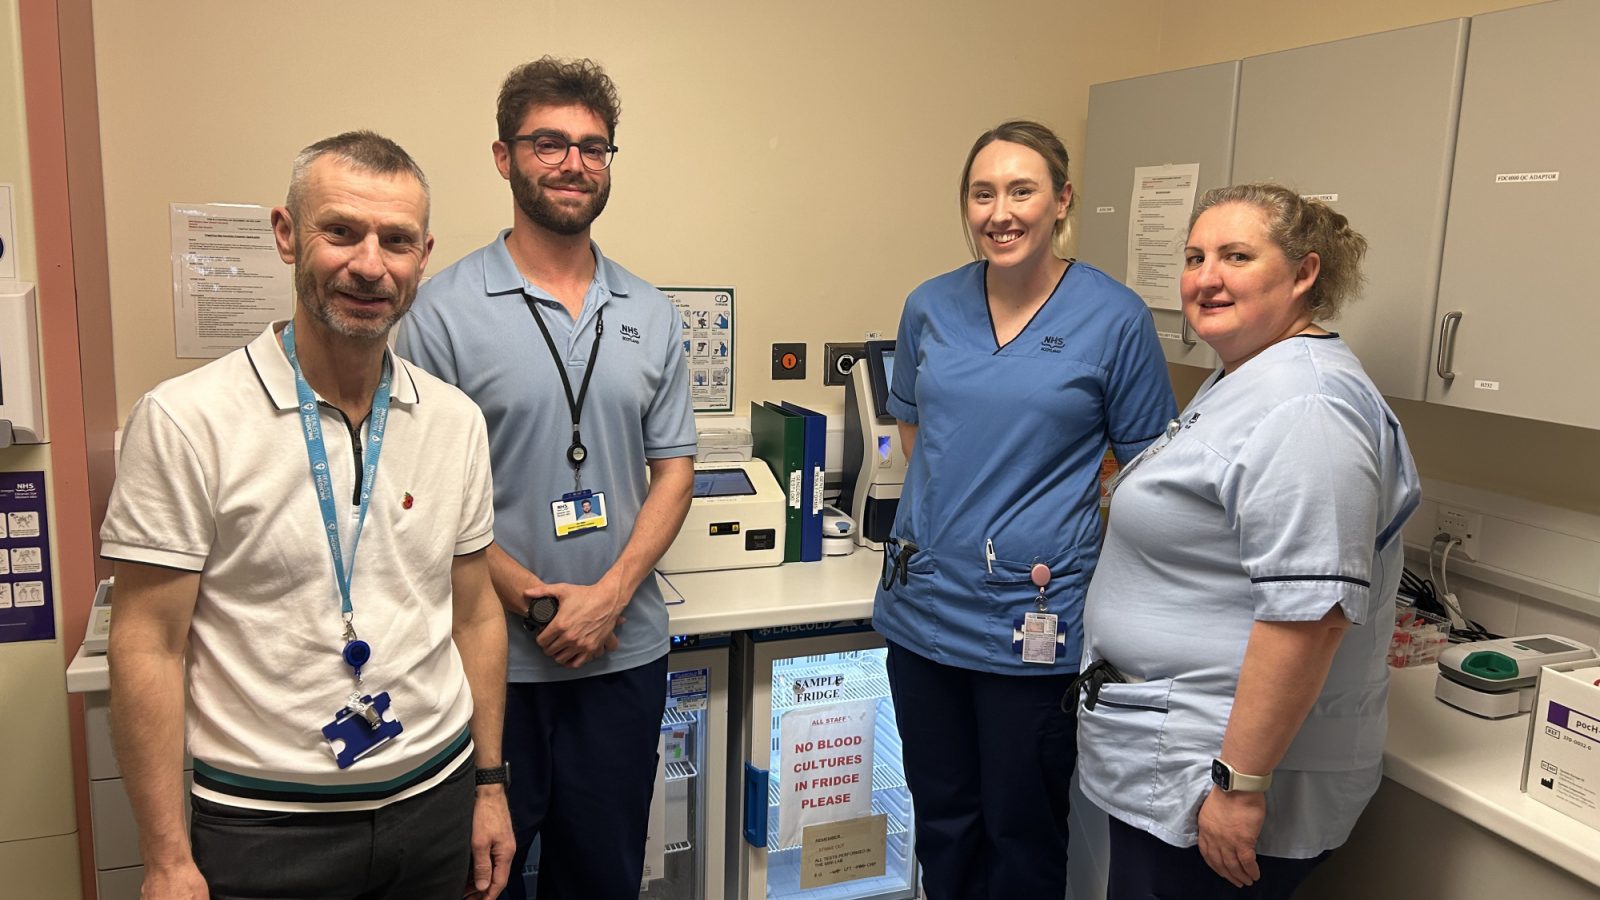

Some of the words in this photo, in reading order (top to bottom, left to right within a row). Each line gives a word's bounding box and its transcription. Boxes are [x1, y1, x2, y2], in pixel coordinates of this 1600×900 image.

[621, 324, 639, 336] NHS
[1043, 336, 1064, 345] NHS
[795, 675, 844, 689] SAMPLE
[797, 688, 840, 703] FRIDGE
[825, 716, 847, 724] STAFF
[795, 742, 814, 754] NO
[817, 735, 862, 750] BLOOD
[793, 754, 862, 773] CULTURES
[795, 780, 808, 792] IN
[812, 773, 859, 789] FRIDGE
[801, 793, 851, 809] PLEASE
